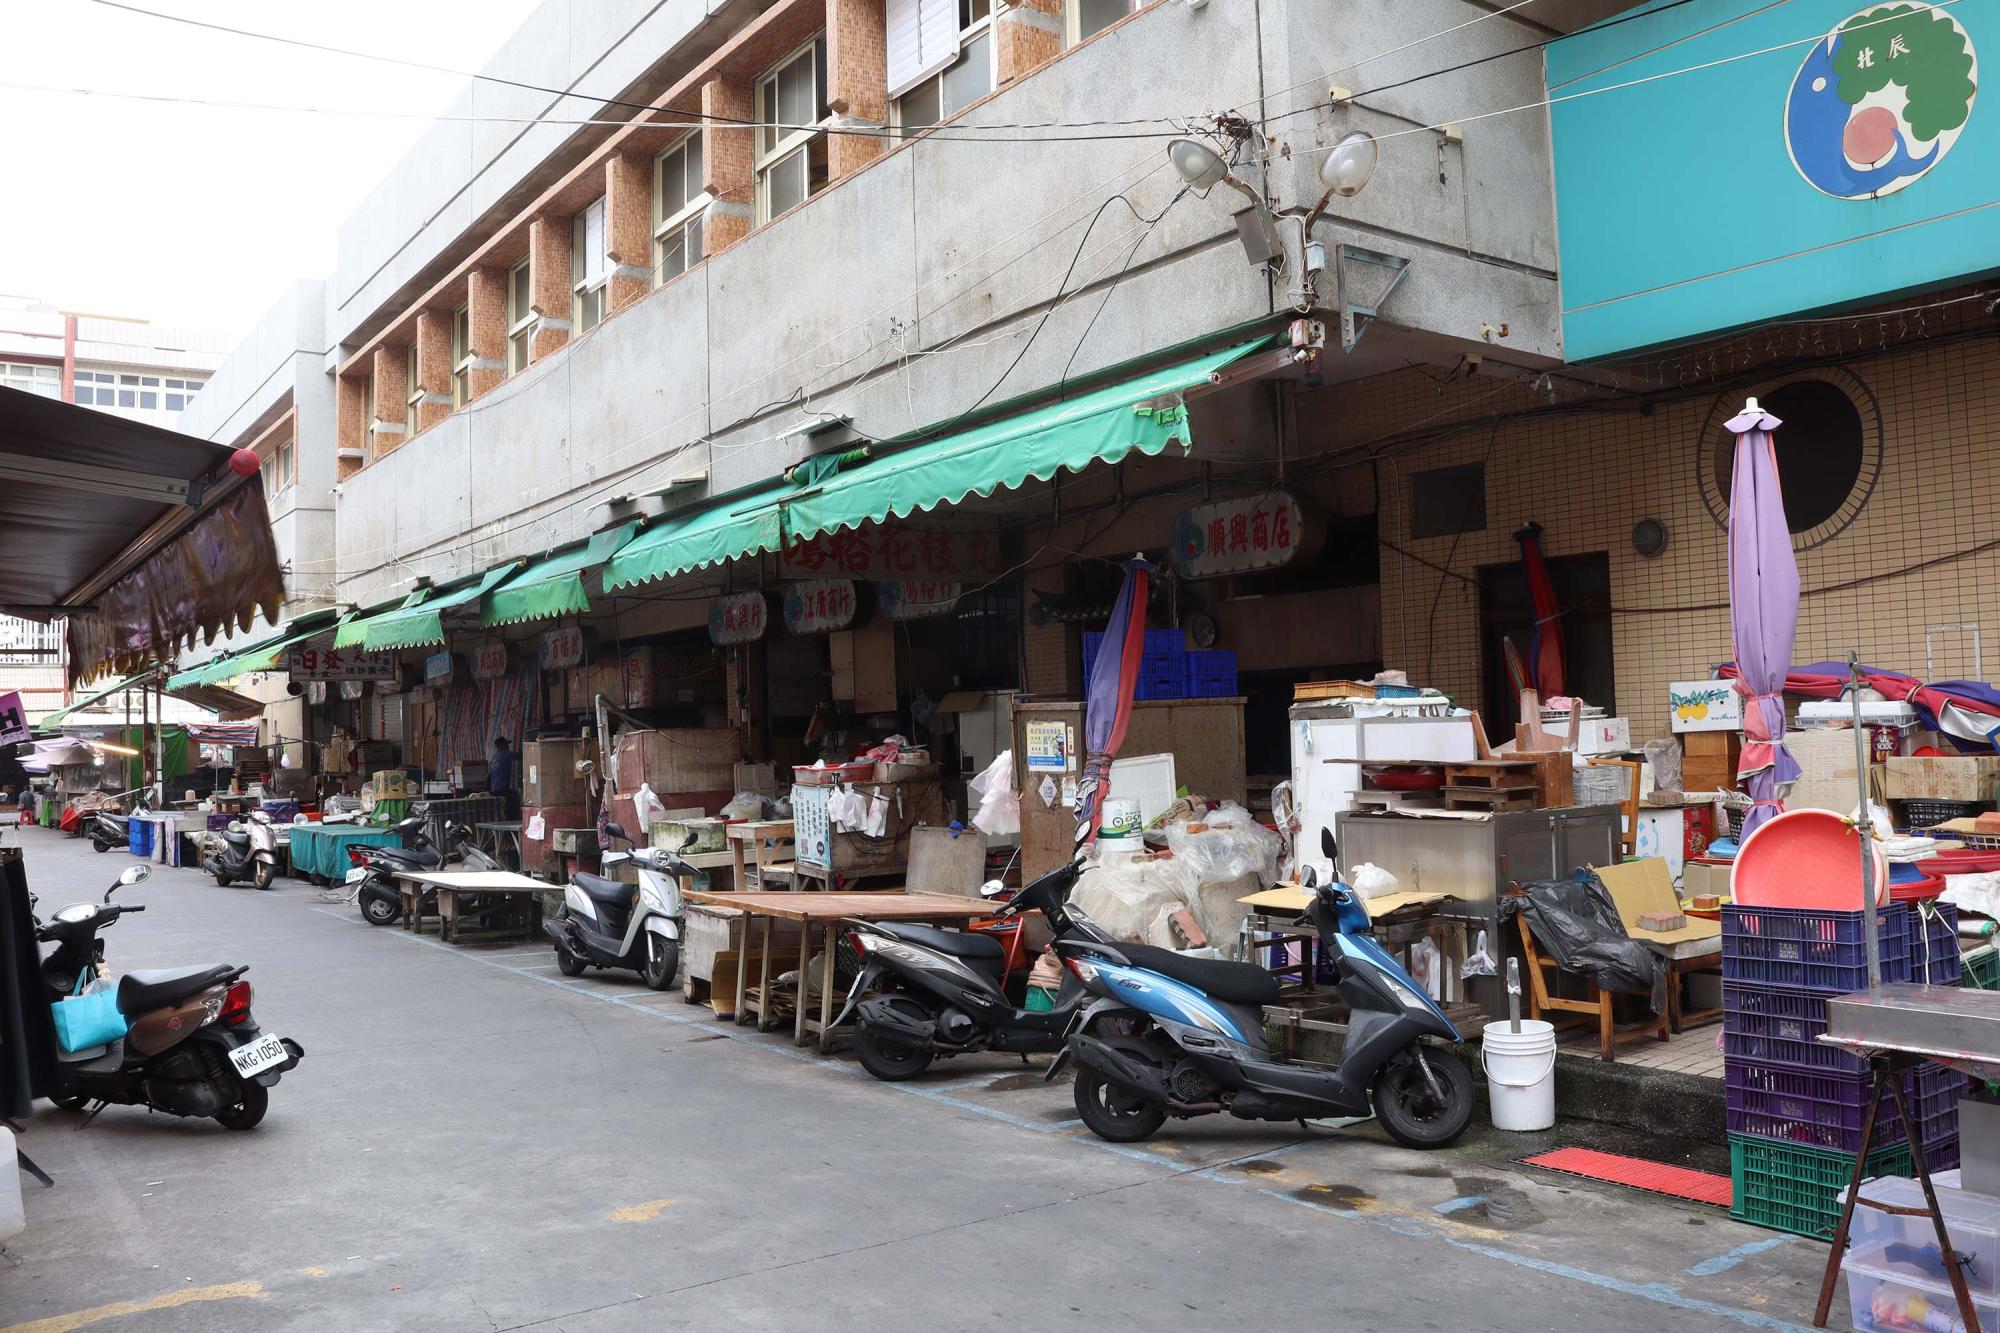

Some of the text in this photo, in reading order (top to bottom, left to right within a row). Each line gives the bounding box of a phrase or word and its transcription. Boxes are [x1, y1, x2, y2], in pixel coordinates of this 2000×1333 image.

[1857, 33, 1910, 69] 北辰
[1208, 505, 1290, 559] 順興商店
